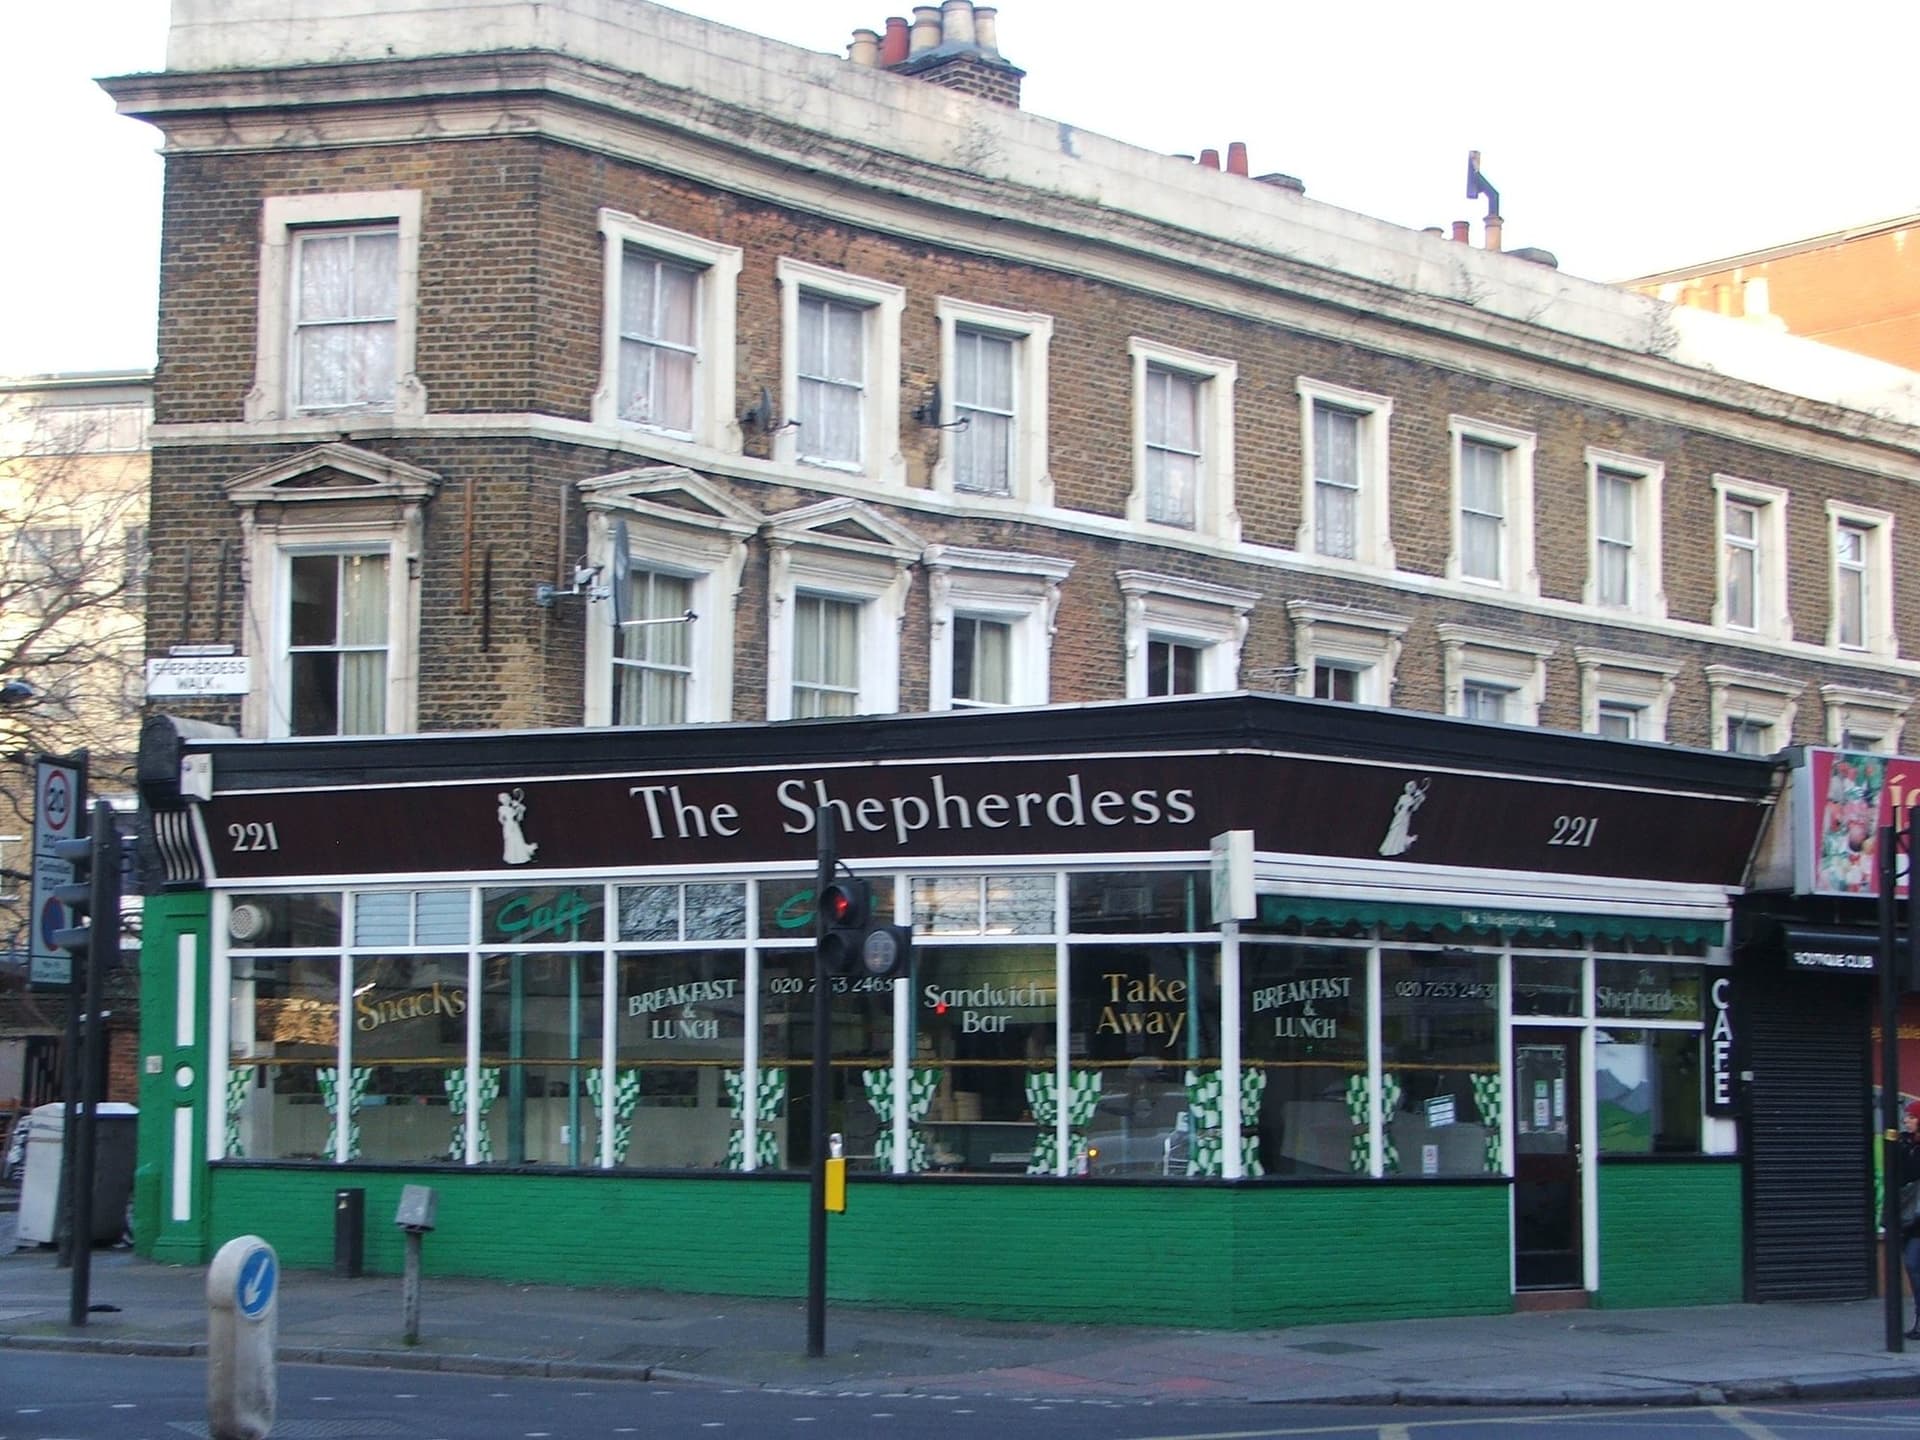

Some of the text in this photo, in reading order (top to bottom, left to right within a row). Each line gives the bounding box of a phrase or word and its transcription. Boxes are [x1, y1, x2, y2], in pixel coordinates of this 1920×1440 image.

[153, 661, 246, 675] SHEPHERDESS
[177, 677, 214, 689] WALK
[629, 774, 1196, 844] The Shepherdess
[227, 822, 279, 851] 221
[1547, 815, 1599, 847] 221
[628, 979, 738, 1017] BREAKFAST
[770, 977, 803, 994] 020
[923, 982, 1046, 1008] Sandwich
[1102, 973, 1186, 1003] Take
[1252, 977, 1351, 1013] BREAKFAST
[356, 982, 466, 1031] Snacks
[682, 1003, 697, 1019] &
[652, 1019, 719, 1040] LUNCH
[962, 1010, 1012, 1034] Bar
[1096, 1005, 1186, 1048] Away
[1275, 1017, 1337, 1039] LUNCH
[1711, 978, 1732, 1104] CAFE
